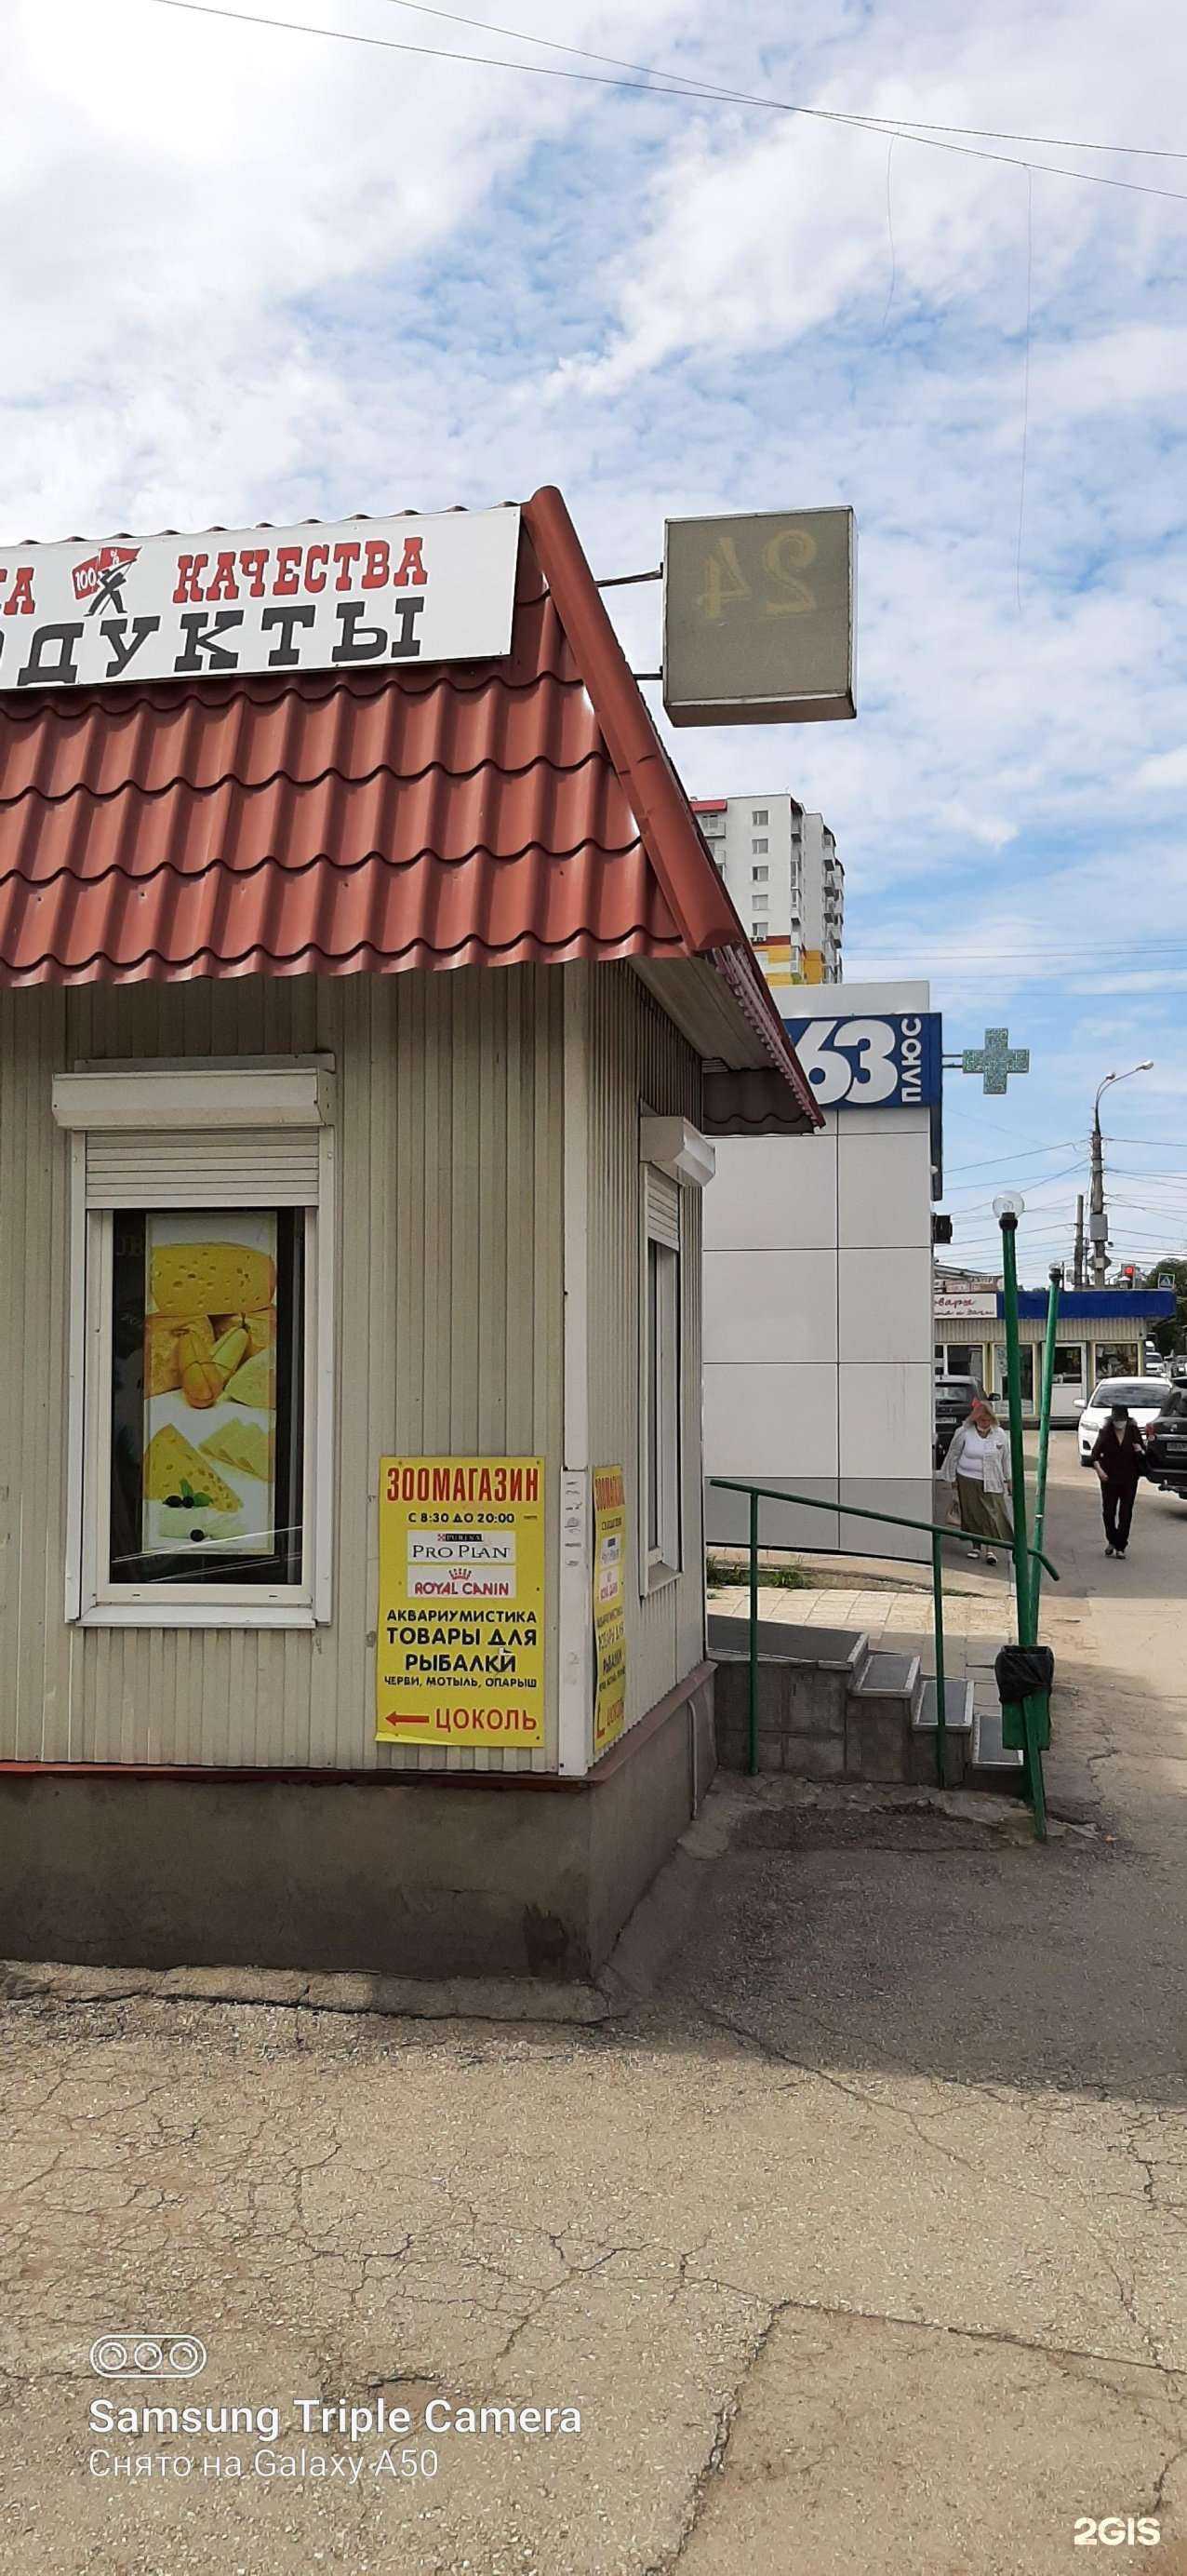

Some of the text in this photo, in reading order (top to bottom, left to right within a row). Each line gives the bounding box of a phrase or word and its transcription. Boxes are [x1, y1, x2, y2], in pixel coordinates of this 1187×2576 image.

[0, 536, 428, 615] А КАЧЕСТВА
[75, 567, 97, 591] 100
[0, 596, 425, 688] ДУКТЫ
[795, 1018, 899, 1105] 63
[900, 1017, 922, 1103] ПЛЮС
[387, 1467, 539, 1502] ЗООМАГАЗИН
[408, 1512, 417, 1523] С
[420, 1512, 449, 1523] 8:30
[452, 1512, 473, 1523] ДО
[477, 1512, 515, 1523] 20:00
[415, 1582, 509, 1595] ROYAL CANIN
[387, 1609, 537, 1623] АКВАРИУМИСТИКА
[387, 1627, 537, 1646] ТОВАРЫ ДЛЯ
[406, 1653, 516, 1672] РЫБАЛКИ
[384, 1676, 537, 1688] ЧЕРВИ, МОТЫЛЬ, ОПАРЫШ
[435, 1708, 537, 1733] ЦОКОЛЬ
